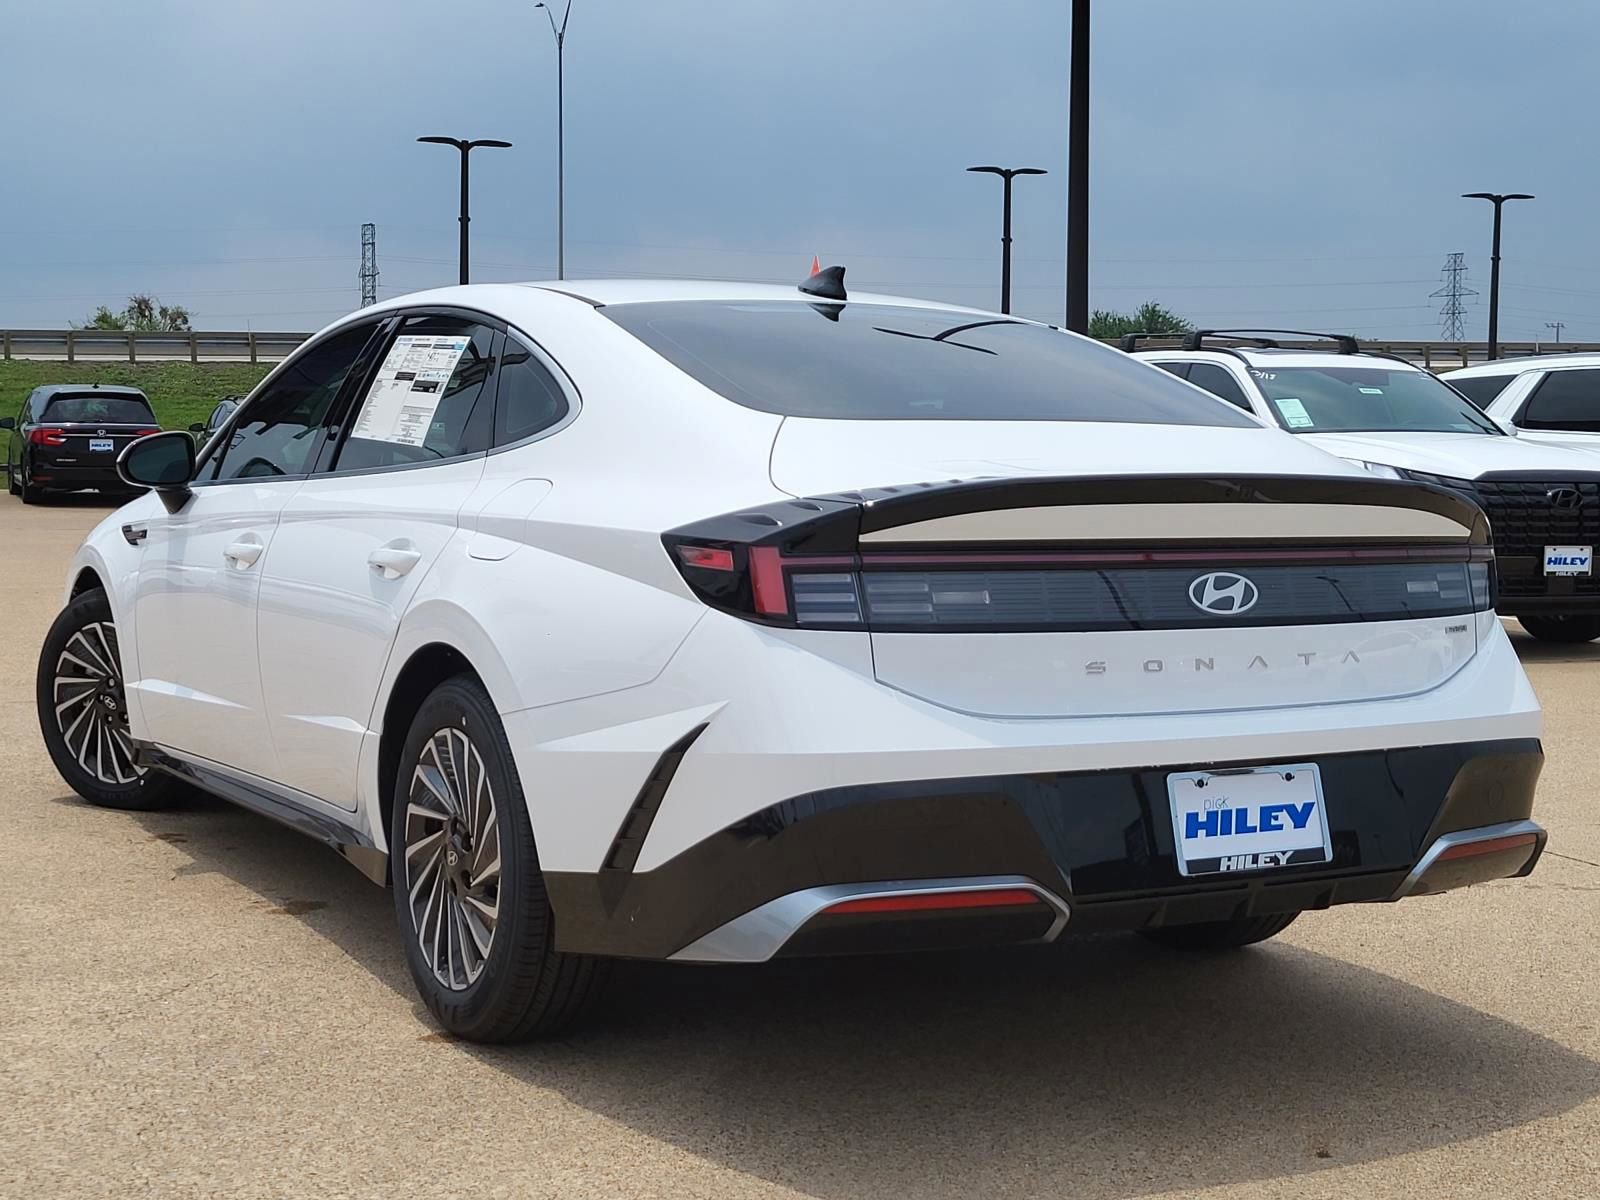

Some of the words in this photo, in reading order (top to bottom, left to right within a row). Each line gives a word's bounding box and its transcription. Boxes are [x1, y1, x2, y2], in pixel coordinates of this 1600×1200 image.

[1546, 556, 1589, 566] HILEY
[1085, 650, 1361, 675] SONATA
[1185, 802, 1316, 839] HILEY
[1219, 850, 1295, 872] HILEY
